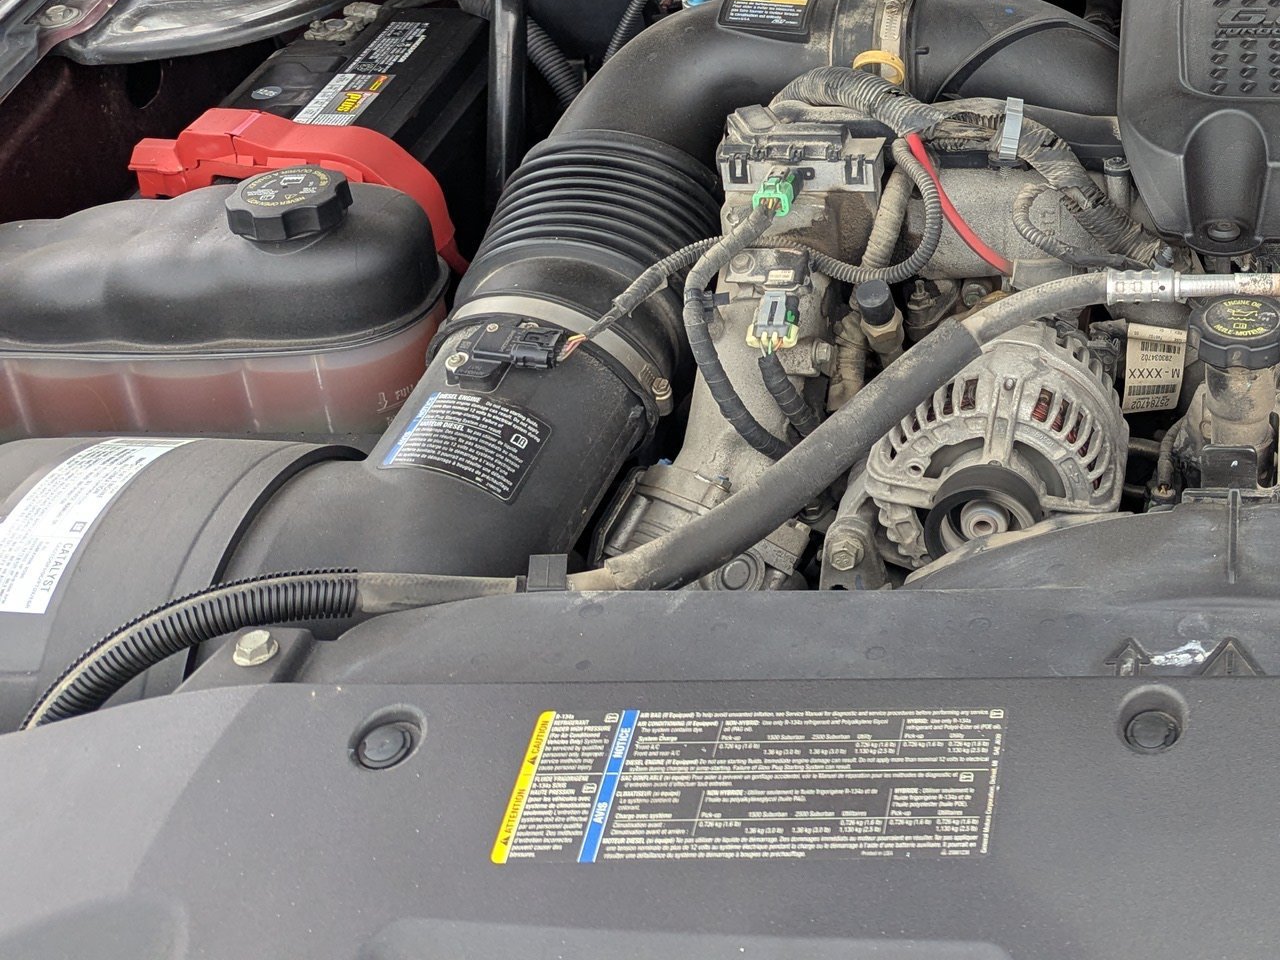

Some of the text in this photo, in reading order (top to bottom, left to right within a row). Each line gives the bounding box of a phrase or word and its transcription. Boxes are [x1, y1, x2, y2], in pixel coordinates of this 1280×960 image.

[1250, 300, 1263, 308] OIL
[458, 394, 482, 403] ENGINE
[443, 422, 465, 432] DIESEL
[40, 542, 74, 592] CATALYST
[531, 720, 550, 754] CAUTION
[612, 727, 631, 758] NOTICE
[505, 788, 526, 834] ATTENTION
[593, 802, 608, 824] AVIS
